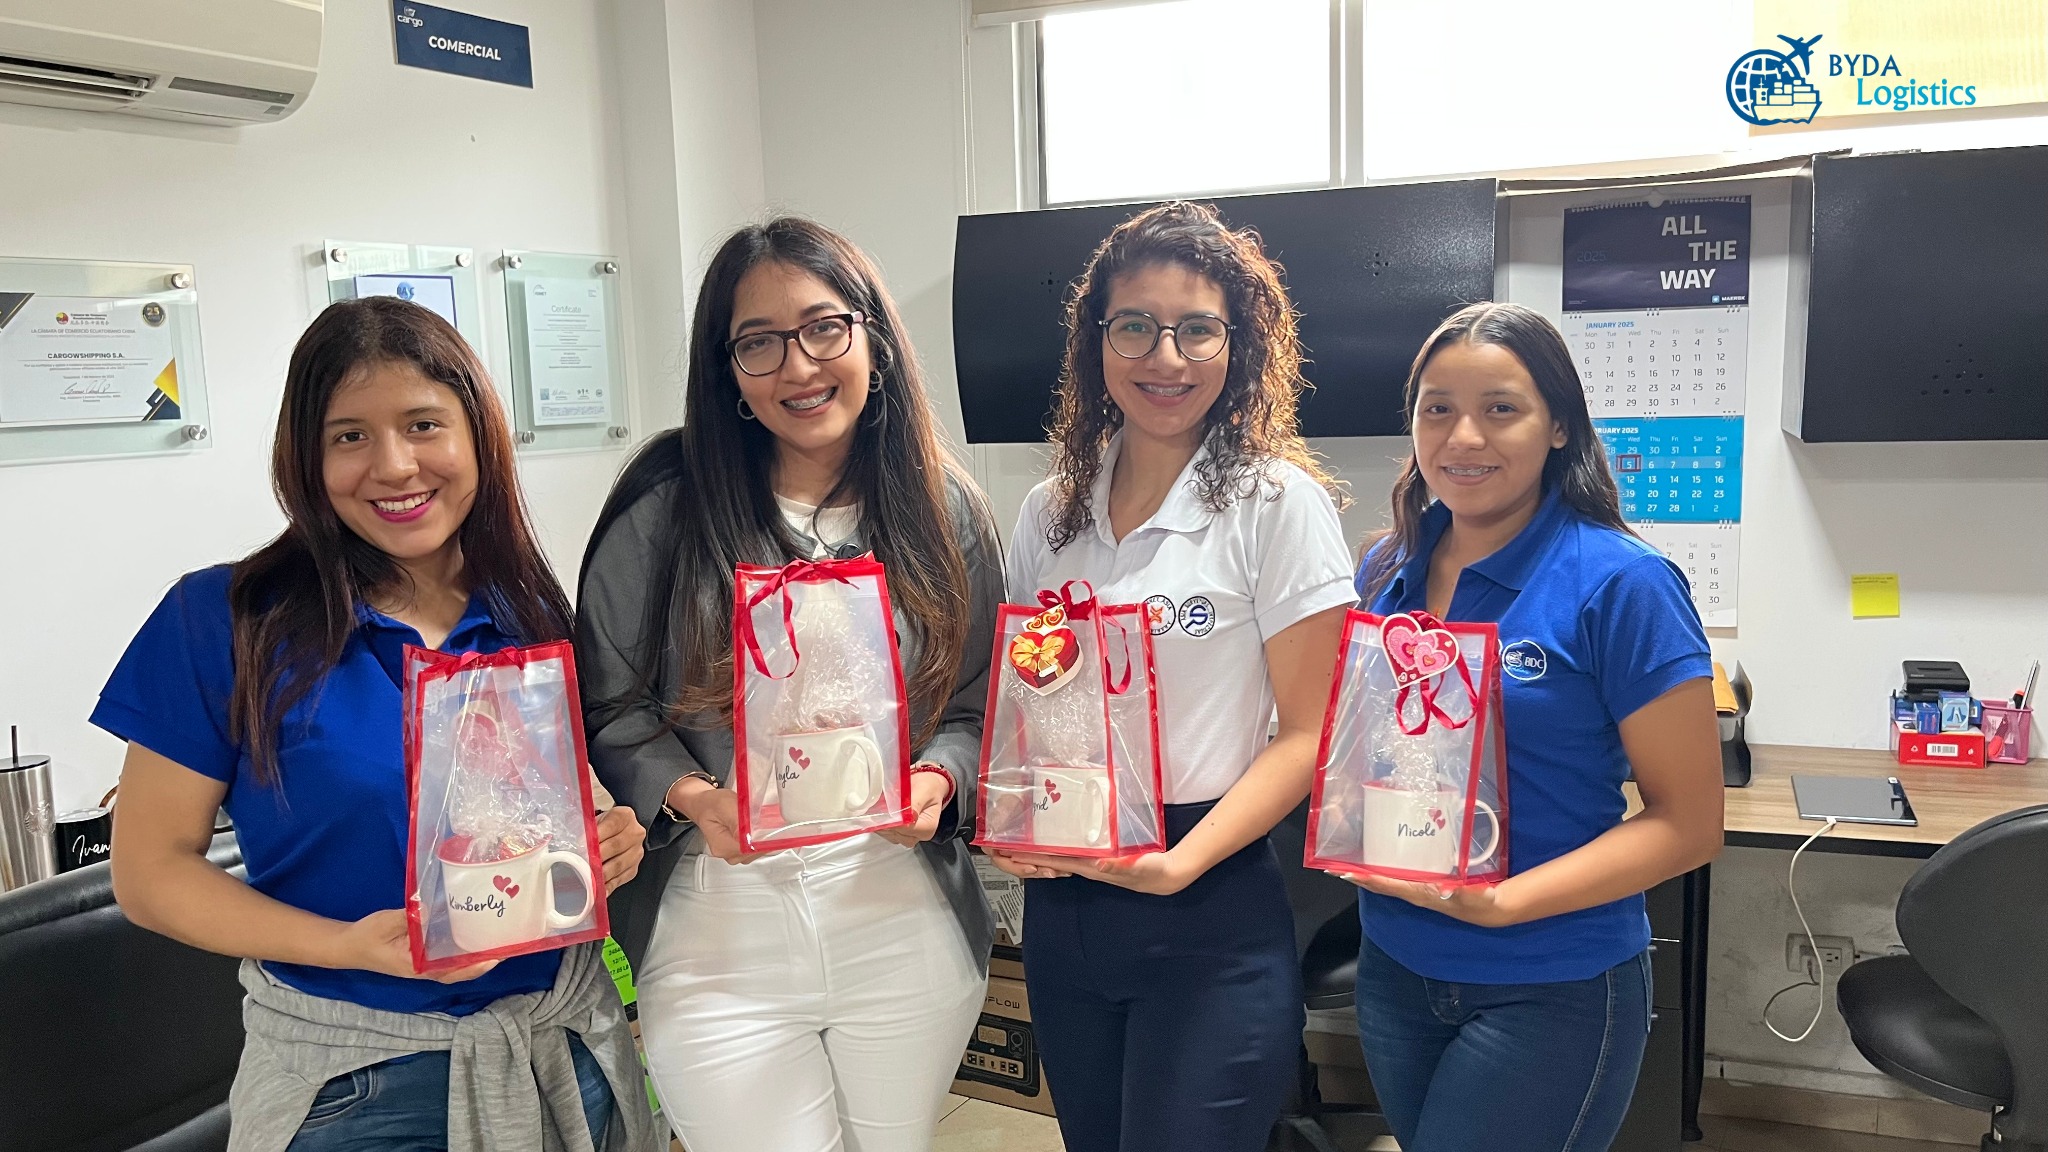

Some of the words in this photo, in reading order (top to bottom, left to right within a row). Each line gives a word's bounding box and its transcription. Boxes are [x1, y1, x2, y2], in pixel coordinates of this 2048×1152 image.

[398, 15, 422, 27] cargo
[428, 36, 501, 60] COMERCIAL
[1661, 215, 1707, 237] ALL
[1577, 251, 1607, 263] 2025
[1688, 240, 1737, 262] THE
[1660, 269, 1716, 290] WAY
[1693, 383, 1703, 391] 25
[1525, 656, 1544, 668] BDC
[1398, 822, 1436, 836] Nicole
[450, 893, 506, 918] Kimberly
